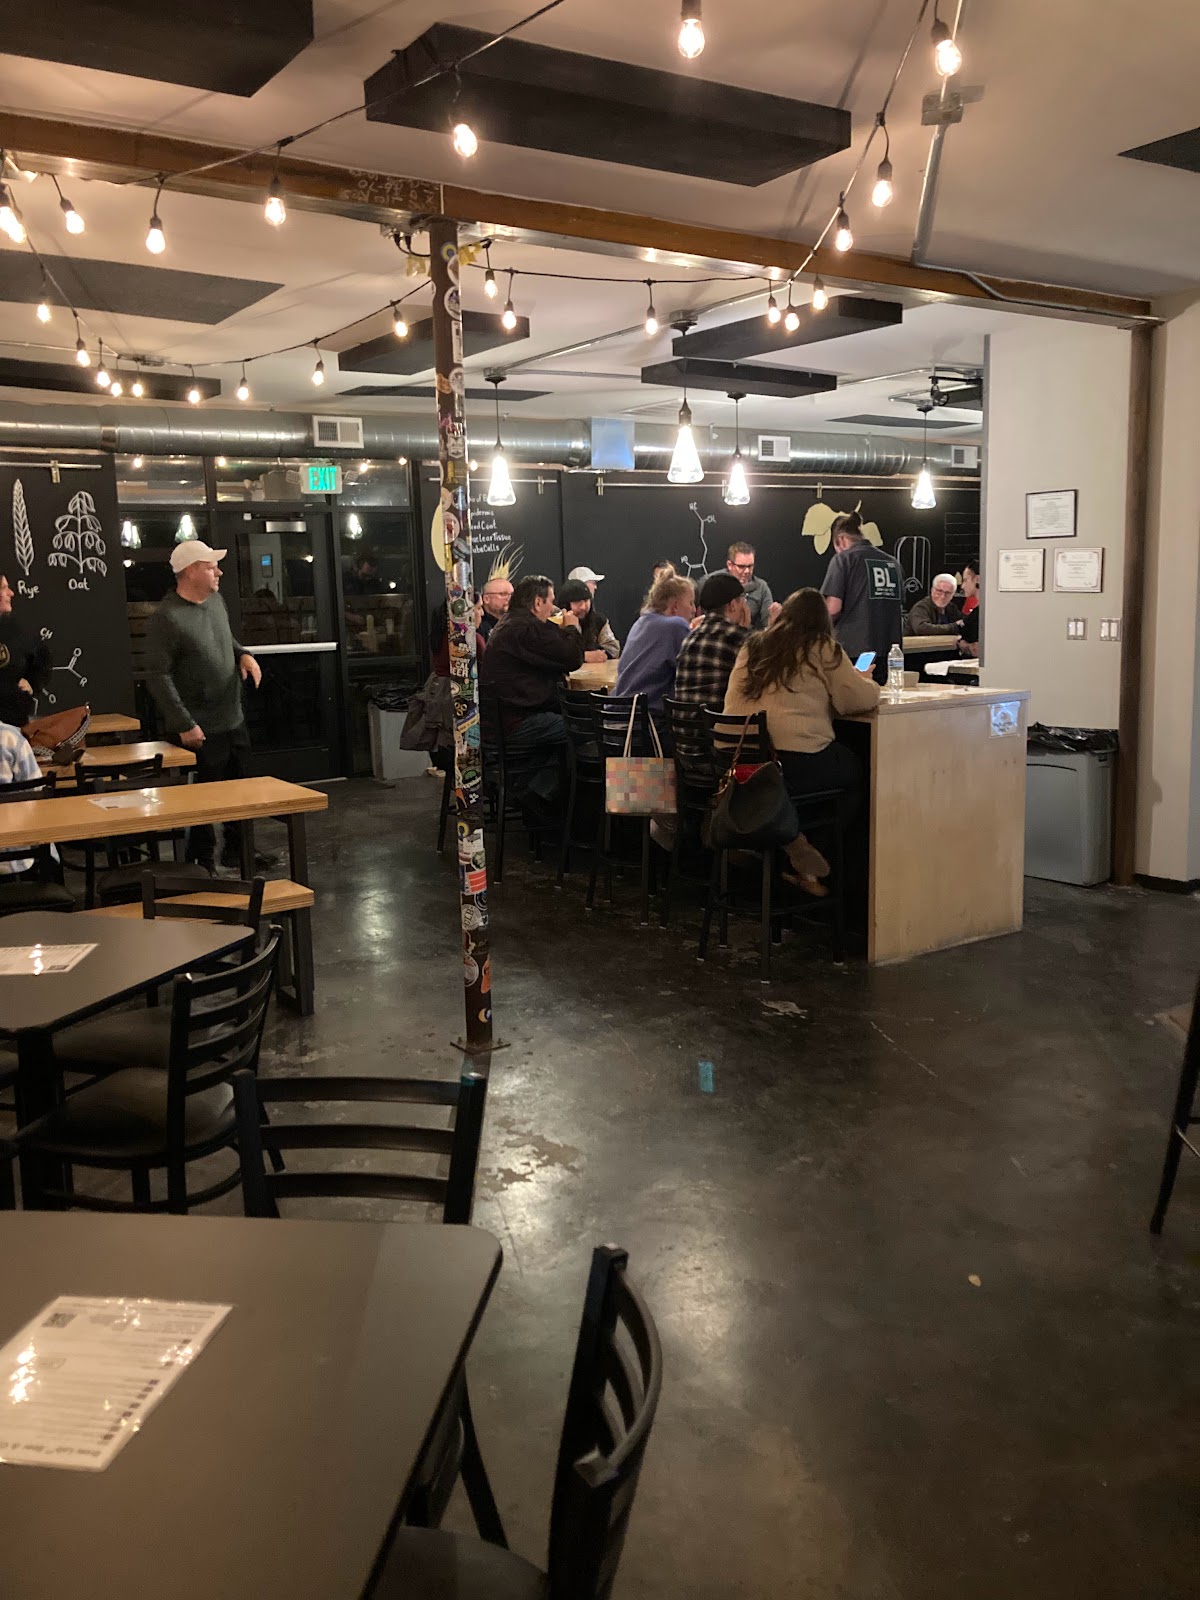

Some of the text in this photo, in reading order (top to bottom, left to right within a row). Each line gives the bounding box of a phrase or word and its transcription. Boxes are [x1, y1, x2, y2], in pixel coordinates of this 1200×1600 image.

[309, 467, 337, 491] EXIT
[470, 508, 494, 520] pidermis
[68, 577, 90, 591] Oat
[873, 567, 896, 588] BL
[17, 580, 40, 599] Rye
